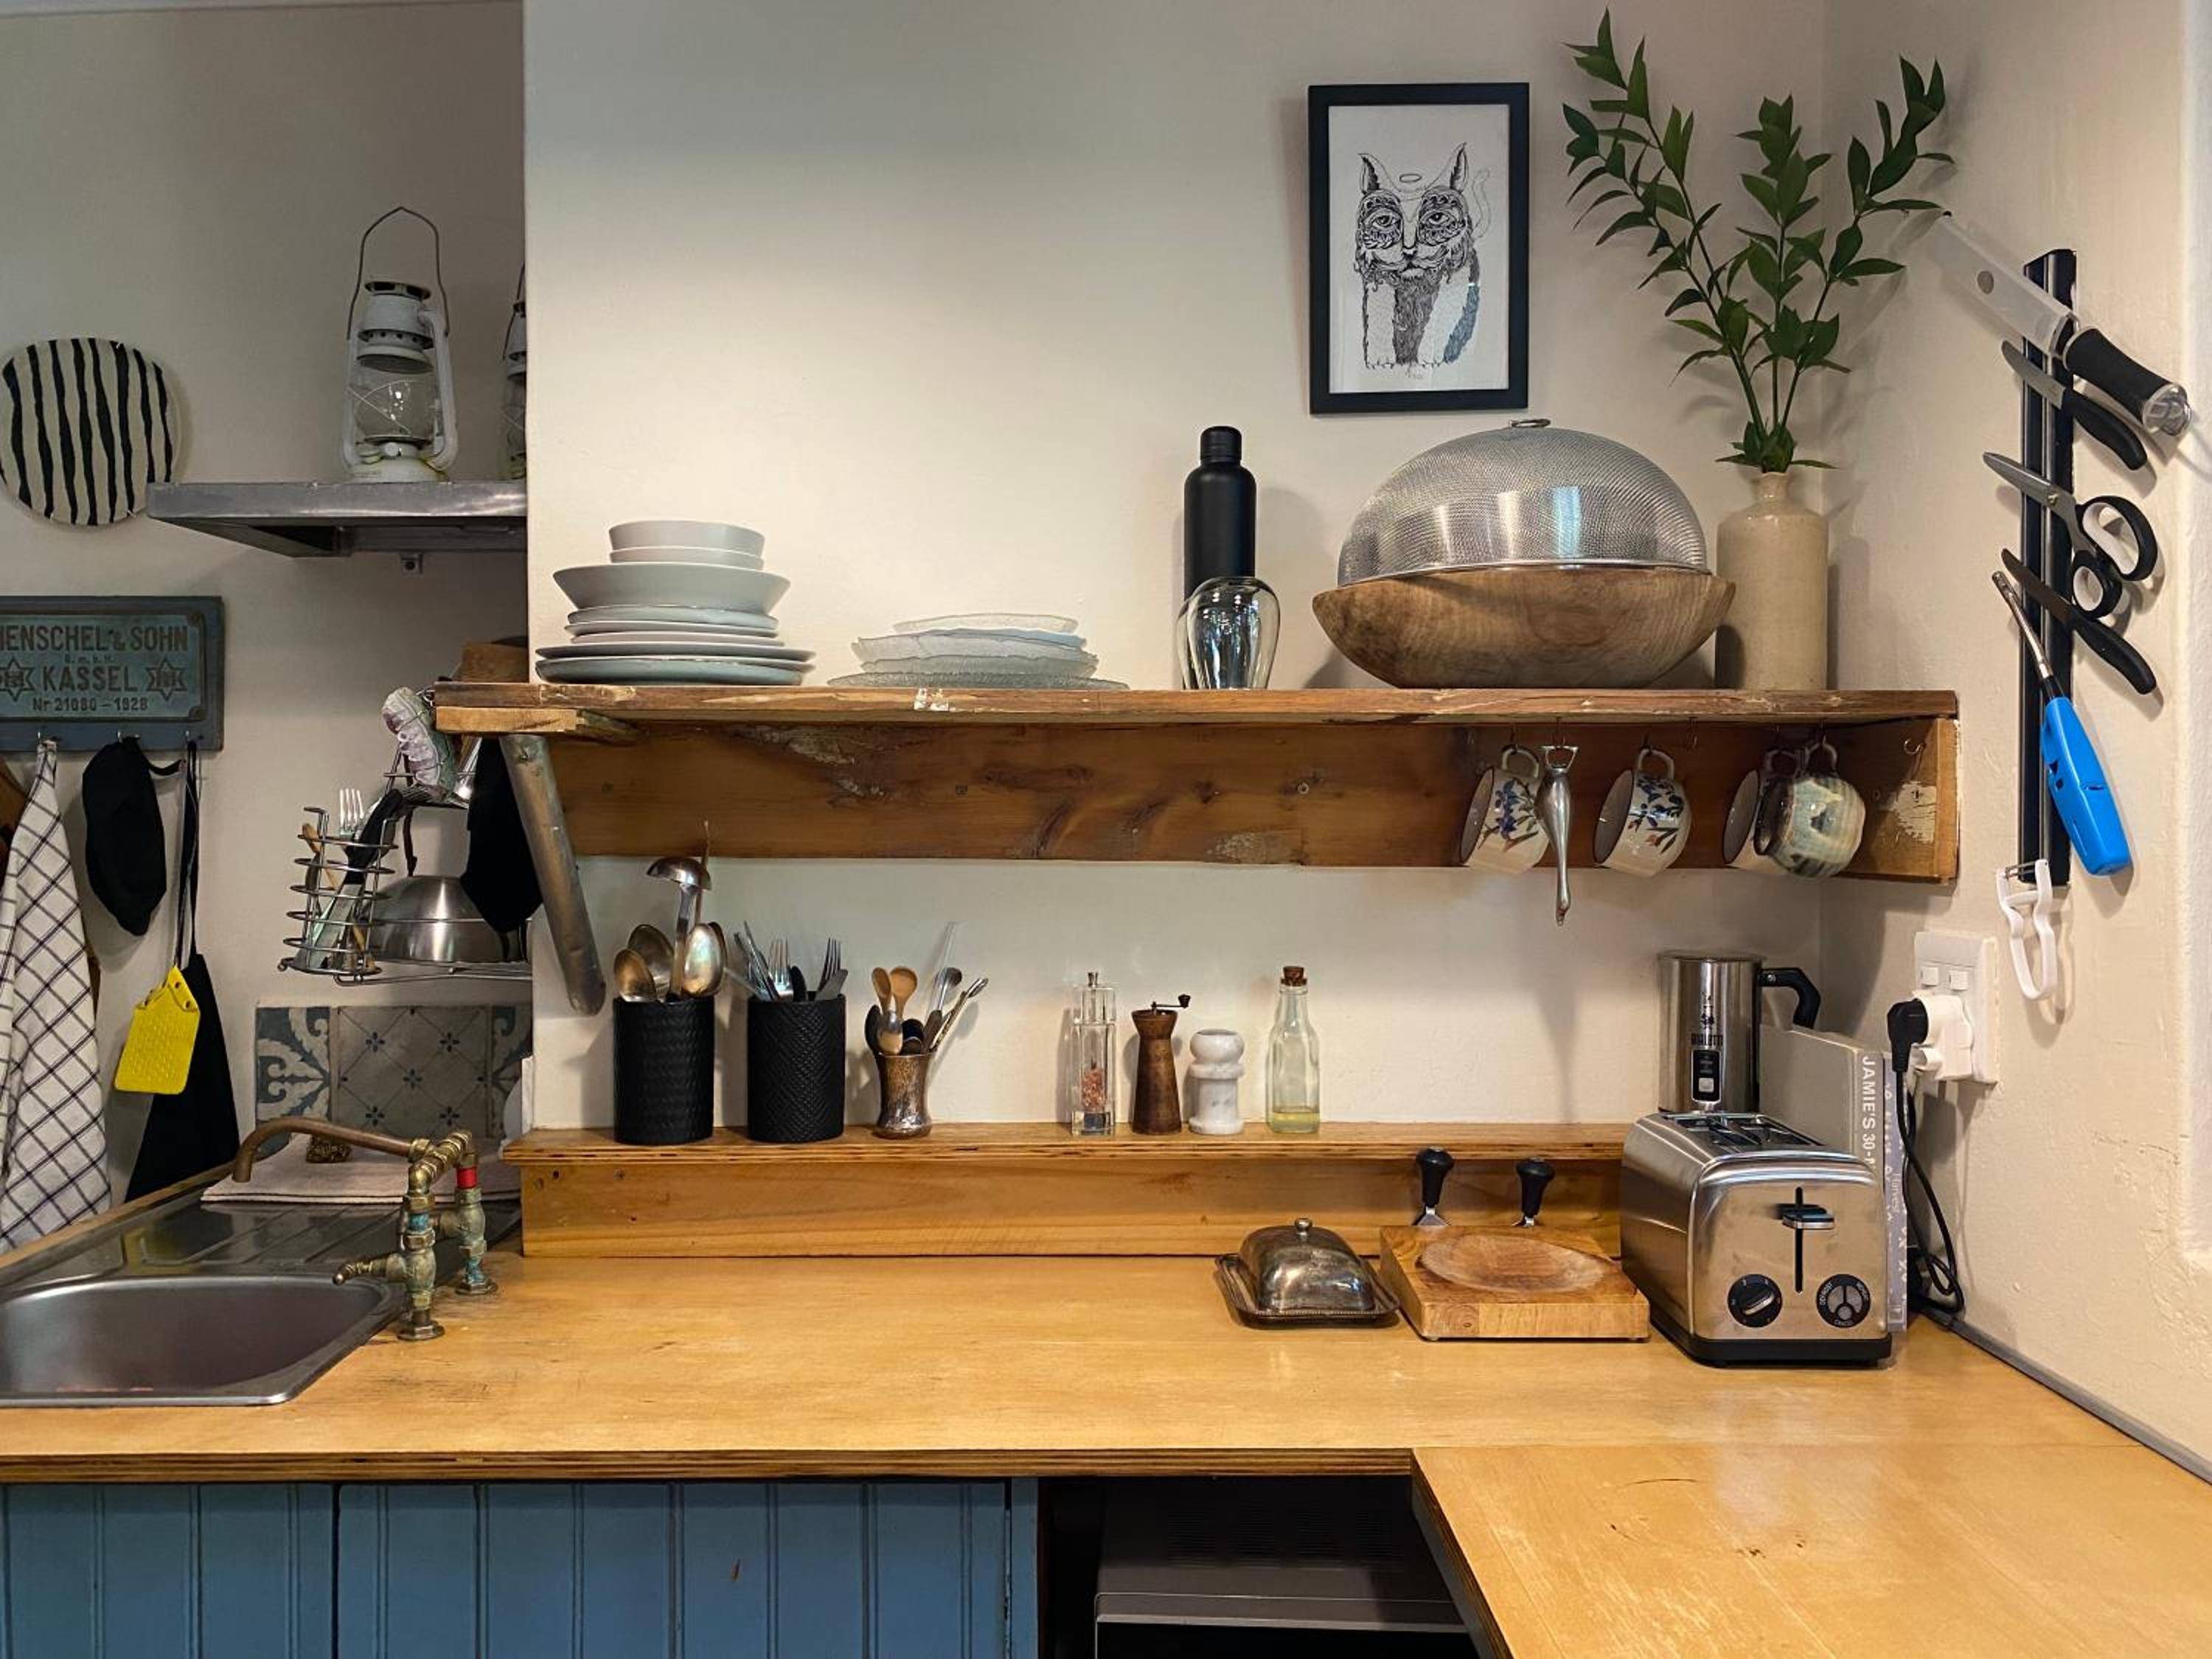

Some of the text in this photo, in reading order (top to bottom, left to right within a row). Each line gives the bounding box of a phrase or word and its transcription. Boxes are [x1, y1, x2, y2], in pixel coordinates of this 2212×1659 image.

[130, 626, 188, 651] SOHN
[43, 665, 139, 692] KASSEL
[1862, 1056, 1877, 1129] JAMIE'S
